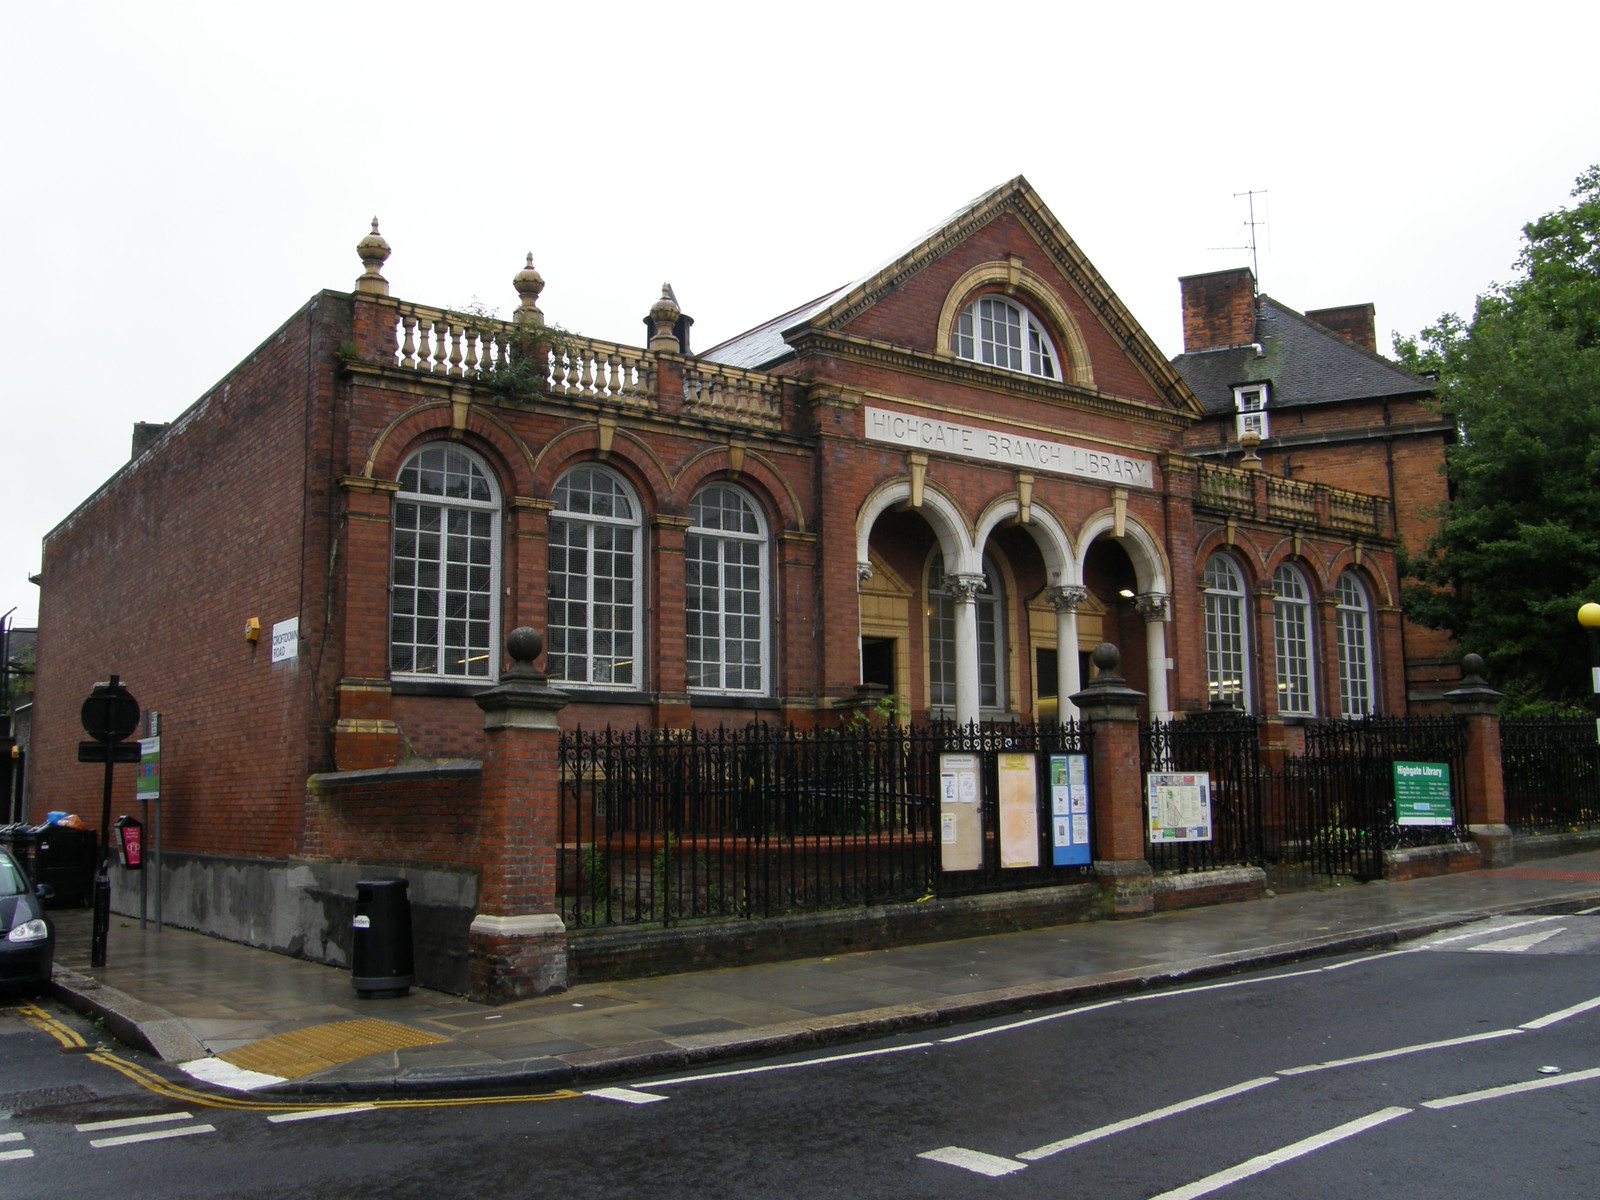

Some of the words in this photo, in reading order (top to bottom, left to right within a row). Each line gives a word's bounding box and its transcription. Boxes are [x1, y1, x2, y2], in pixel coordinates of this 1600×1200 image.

[986, 434, 1061, 466] BRANCH
[274, 646, 286, 658] ROAD
[1397, 765, 1422, 776] Highgate
[1422, 766, 1442, 777] Library
